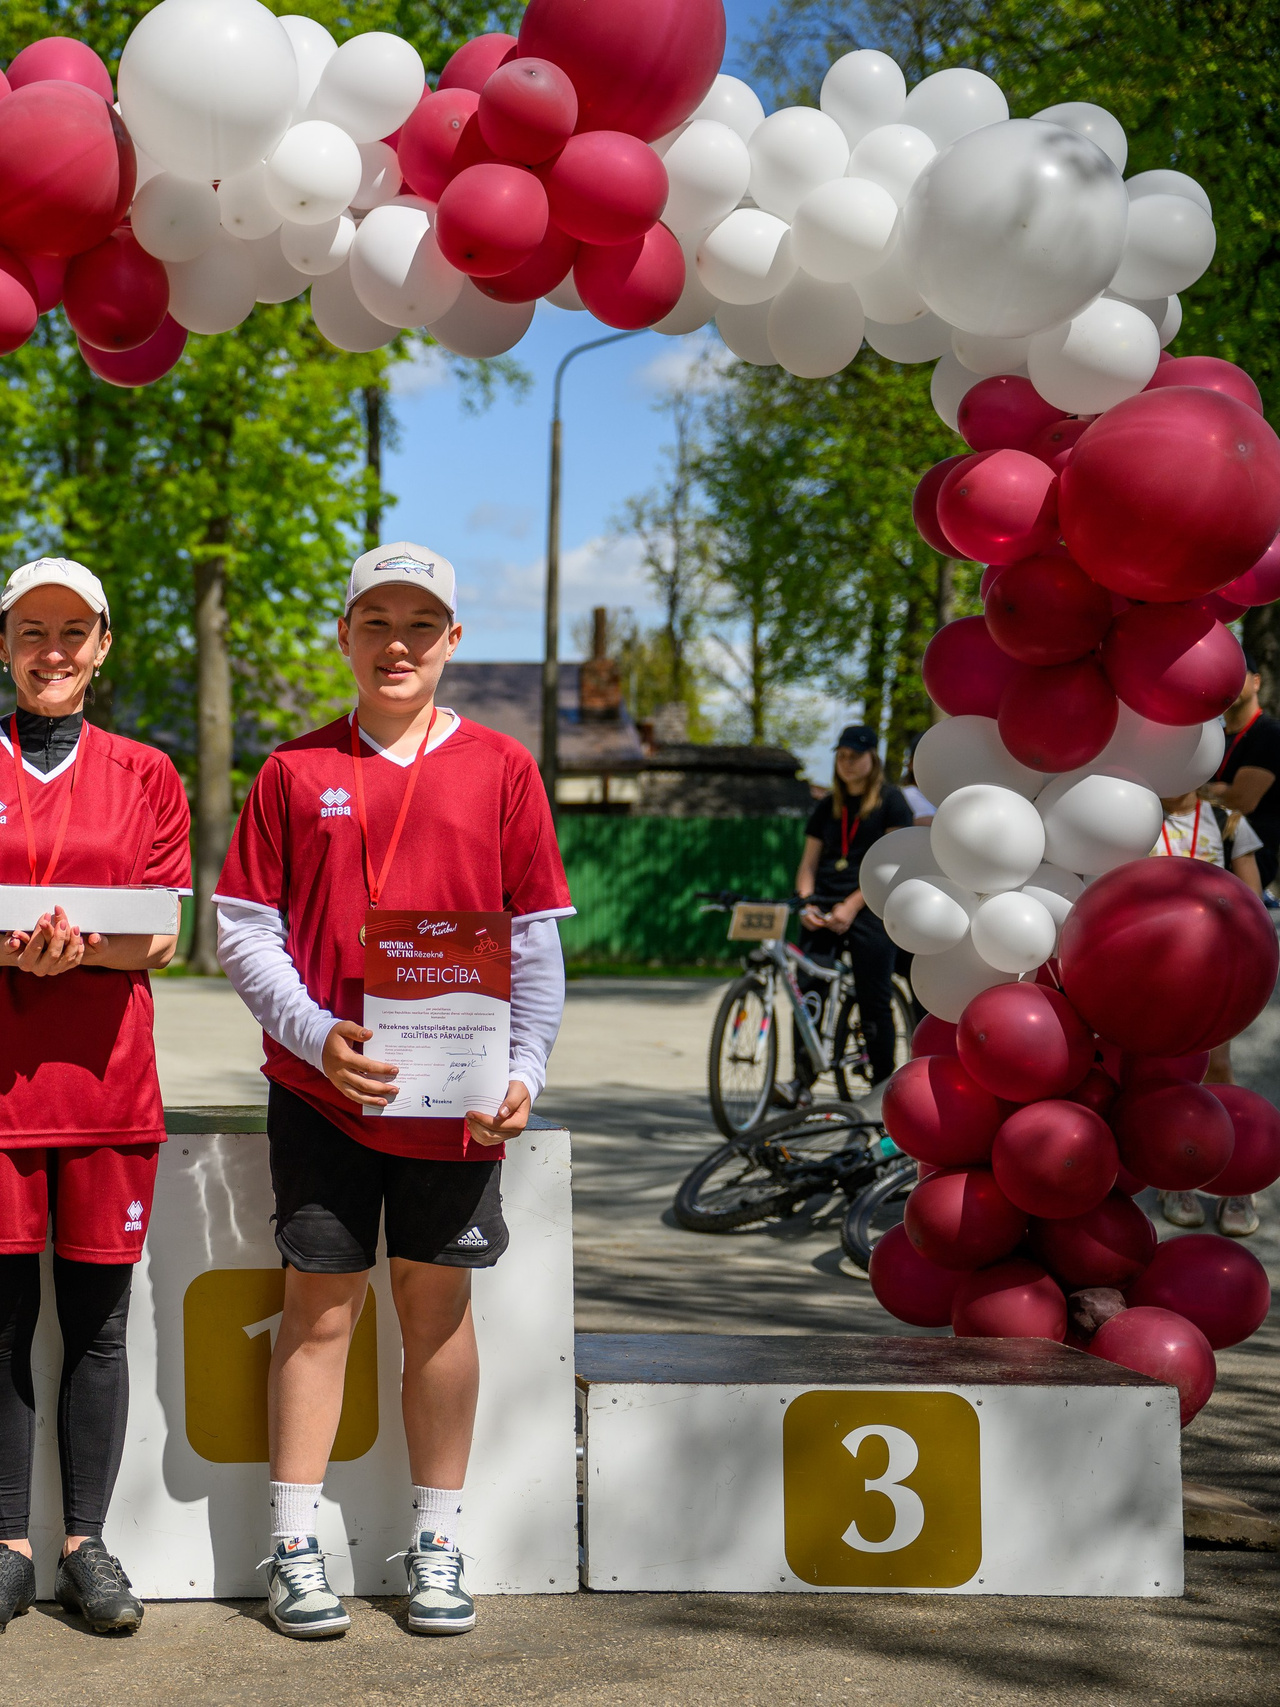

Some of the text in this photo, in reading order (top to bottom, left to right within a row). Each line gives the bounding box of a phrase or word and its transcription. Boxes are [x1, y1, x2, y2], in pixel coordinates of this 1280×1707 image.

[320, 806, 351, 818] errea
[396, 965, 481, 984] PATEICĪBA
[378, 1023, 497, 1033] Rēzeknes valstspilsētas pašvaldības
[401, 1031, 474, 1040] IZGLĪTĪBAS PĀRVALDE
[457, 1238, 489, 1246] adidas
[841, 1424, 925, 1553] 3
